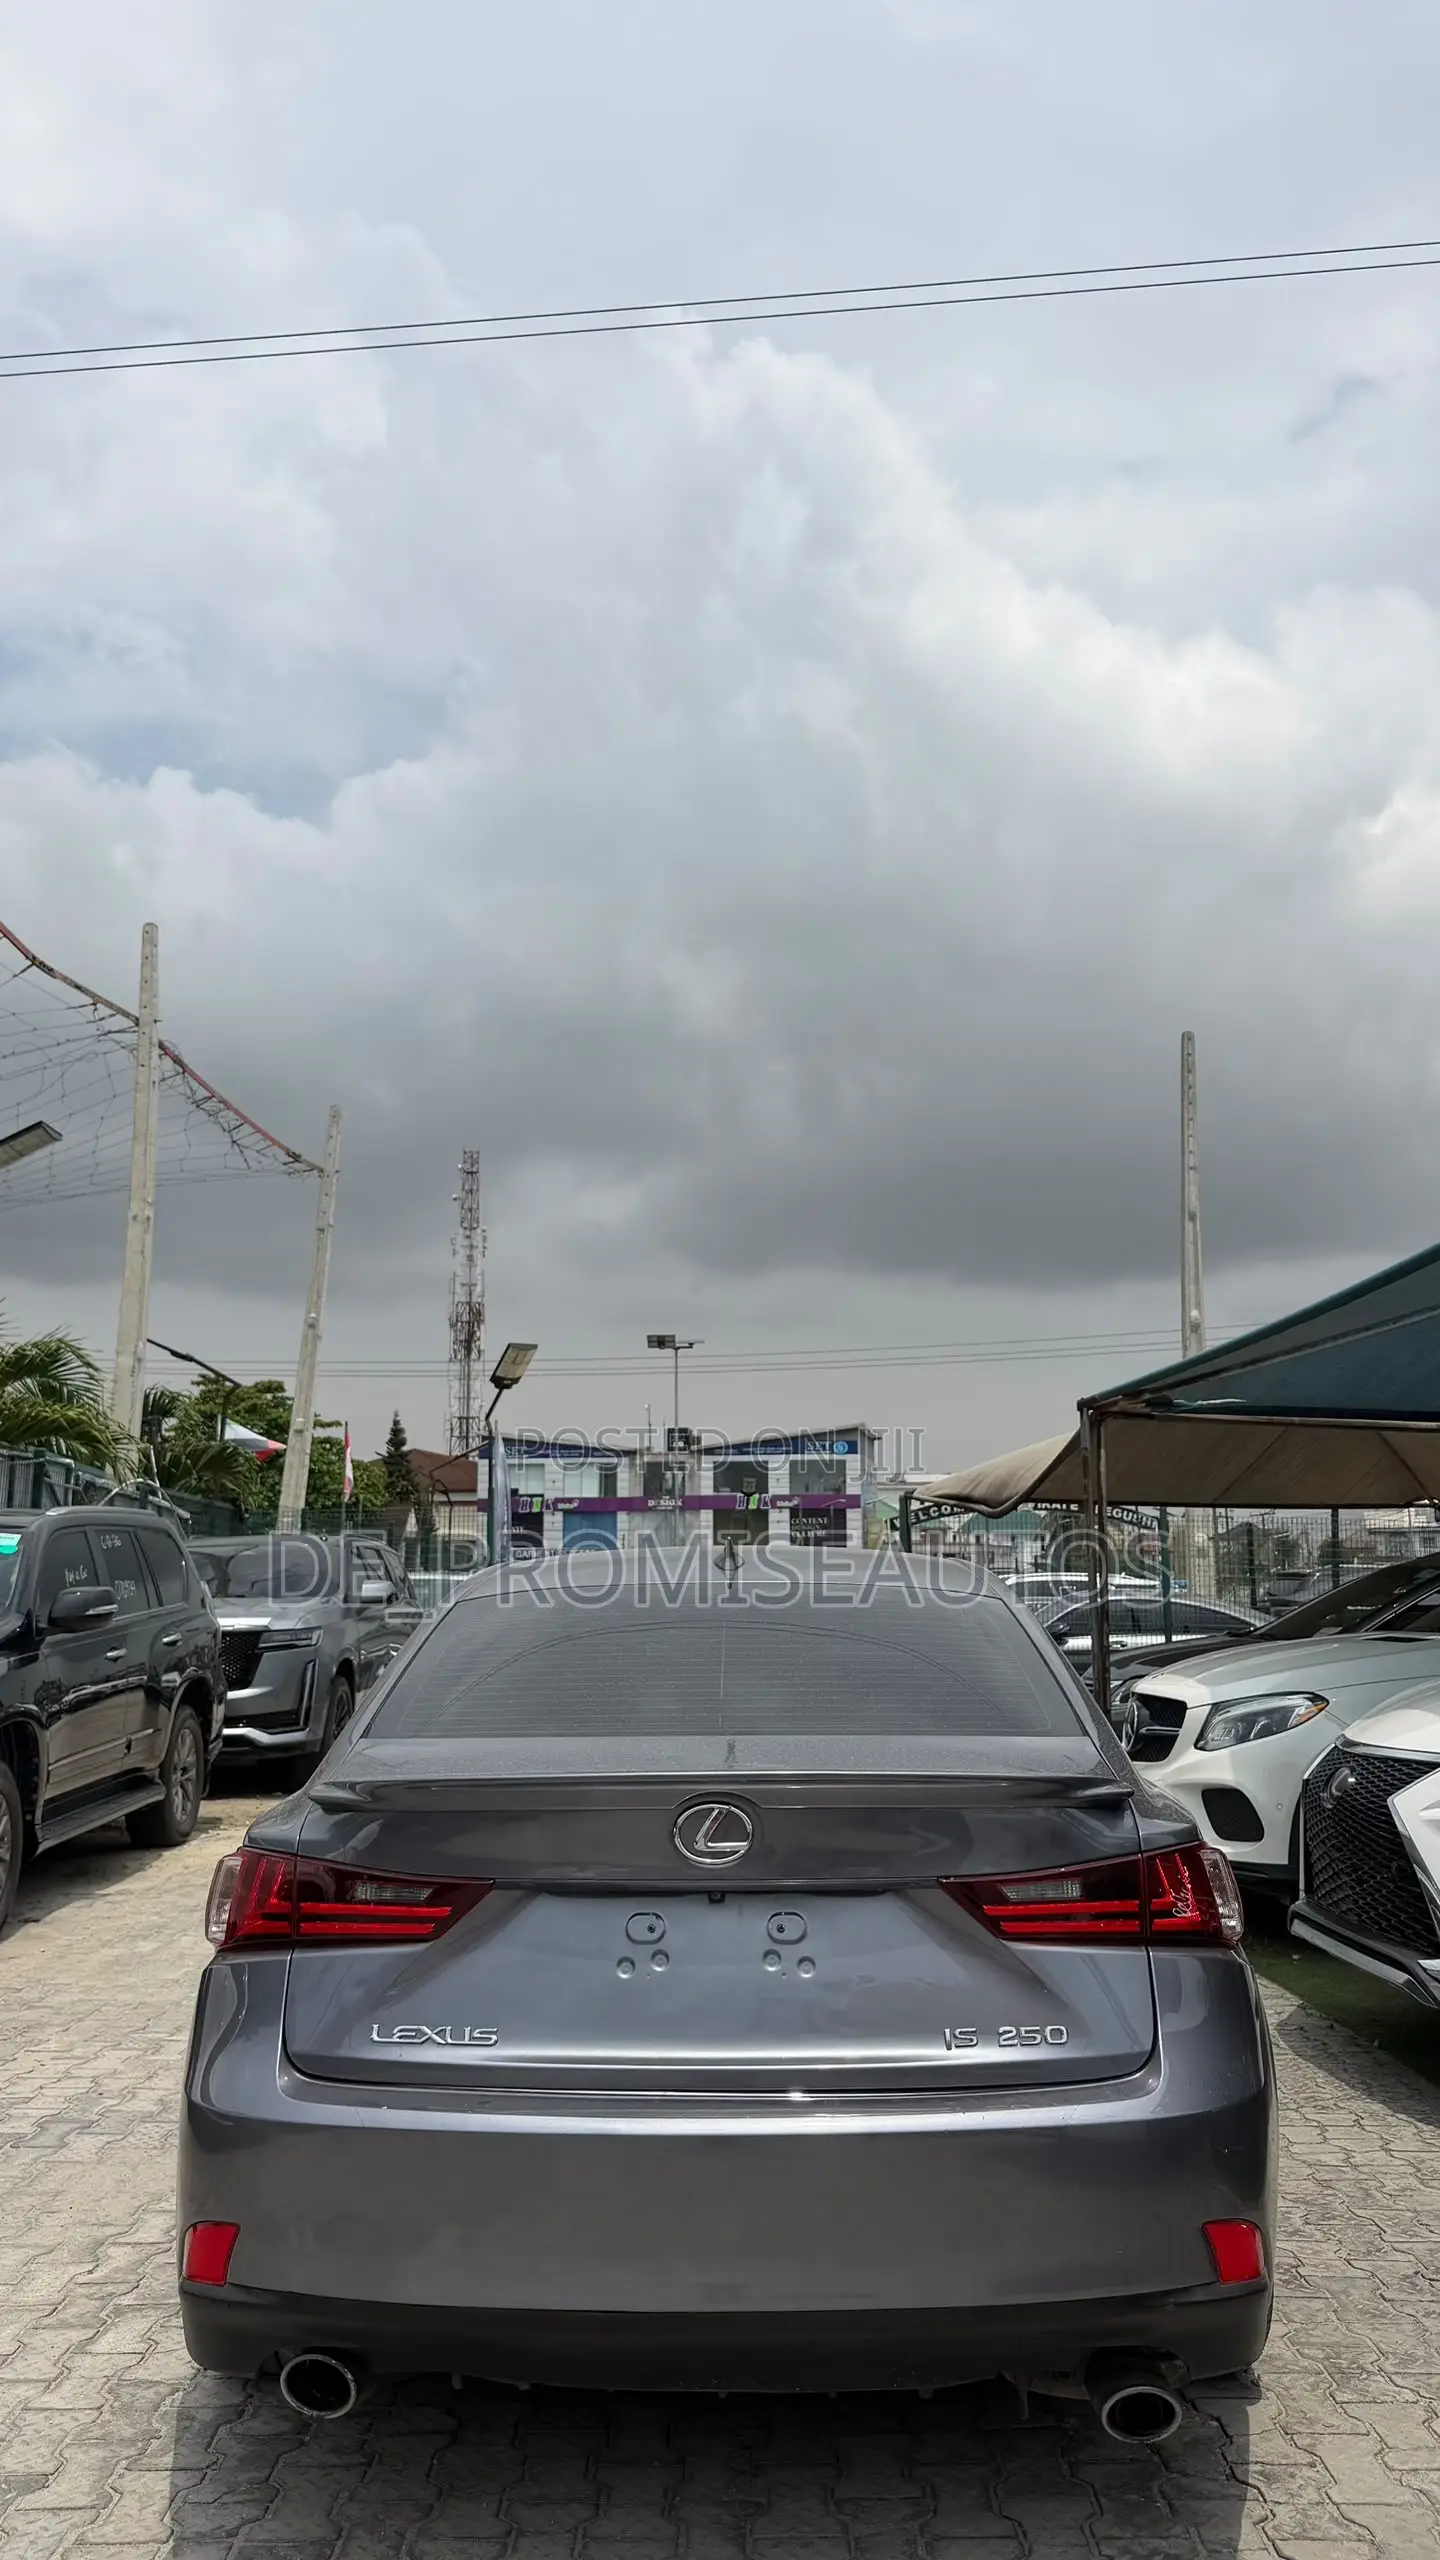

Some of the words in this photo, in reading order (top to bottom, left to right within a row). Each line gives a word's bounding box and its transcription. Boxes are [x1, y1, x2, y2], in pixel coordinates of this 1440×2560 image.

[893, 1506, 965, 1528] ELCO
[370, 2023, 498, 2046] LEXUS
[943, 2027, 979, 2050] IS
[997, 2025, 1068, 2047] 250
